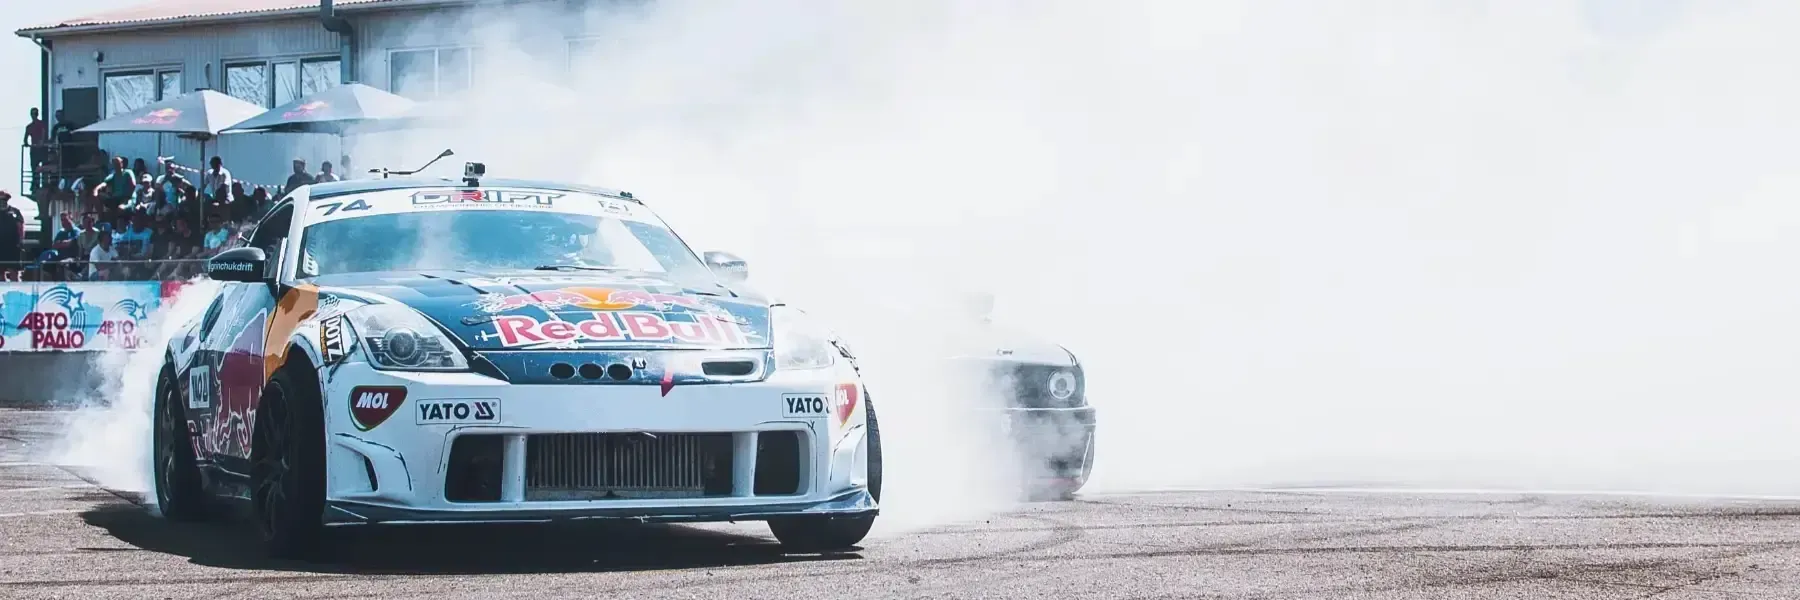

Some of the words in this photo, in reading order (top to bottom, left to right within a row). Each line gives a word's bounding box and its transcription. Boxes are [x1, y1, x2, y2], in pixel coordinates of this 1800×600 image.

[408, 190, 567, 205] DRIFT
[316, 199, 372, 216] 74
[17, 312, 68, 329] АВТО
[97, 320, 134, 335] АВТО
[497, 312, 615, 346] Red
[623, 311, 744, 343] Bull
[32, 331, 85, 349] РАДІО
[356, 392, 389, 409] MOL
[786, 397, 823, 413] YATO
[420, 403, 470, 420] YATO
